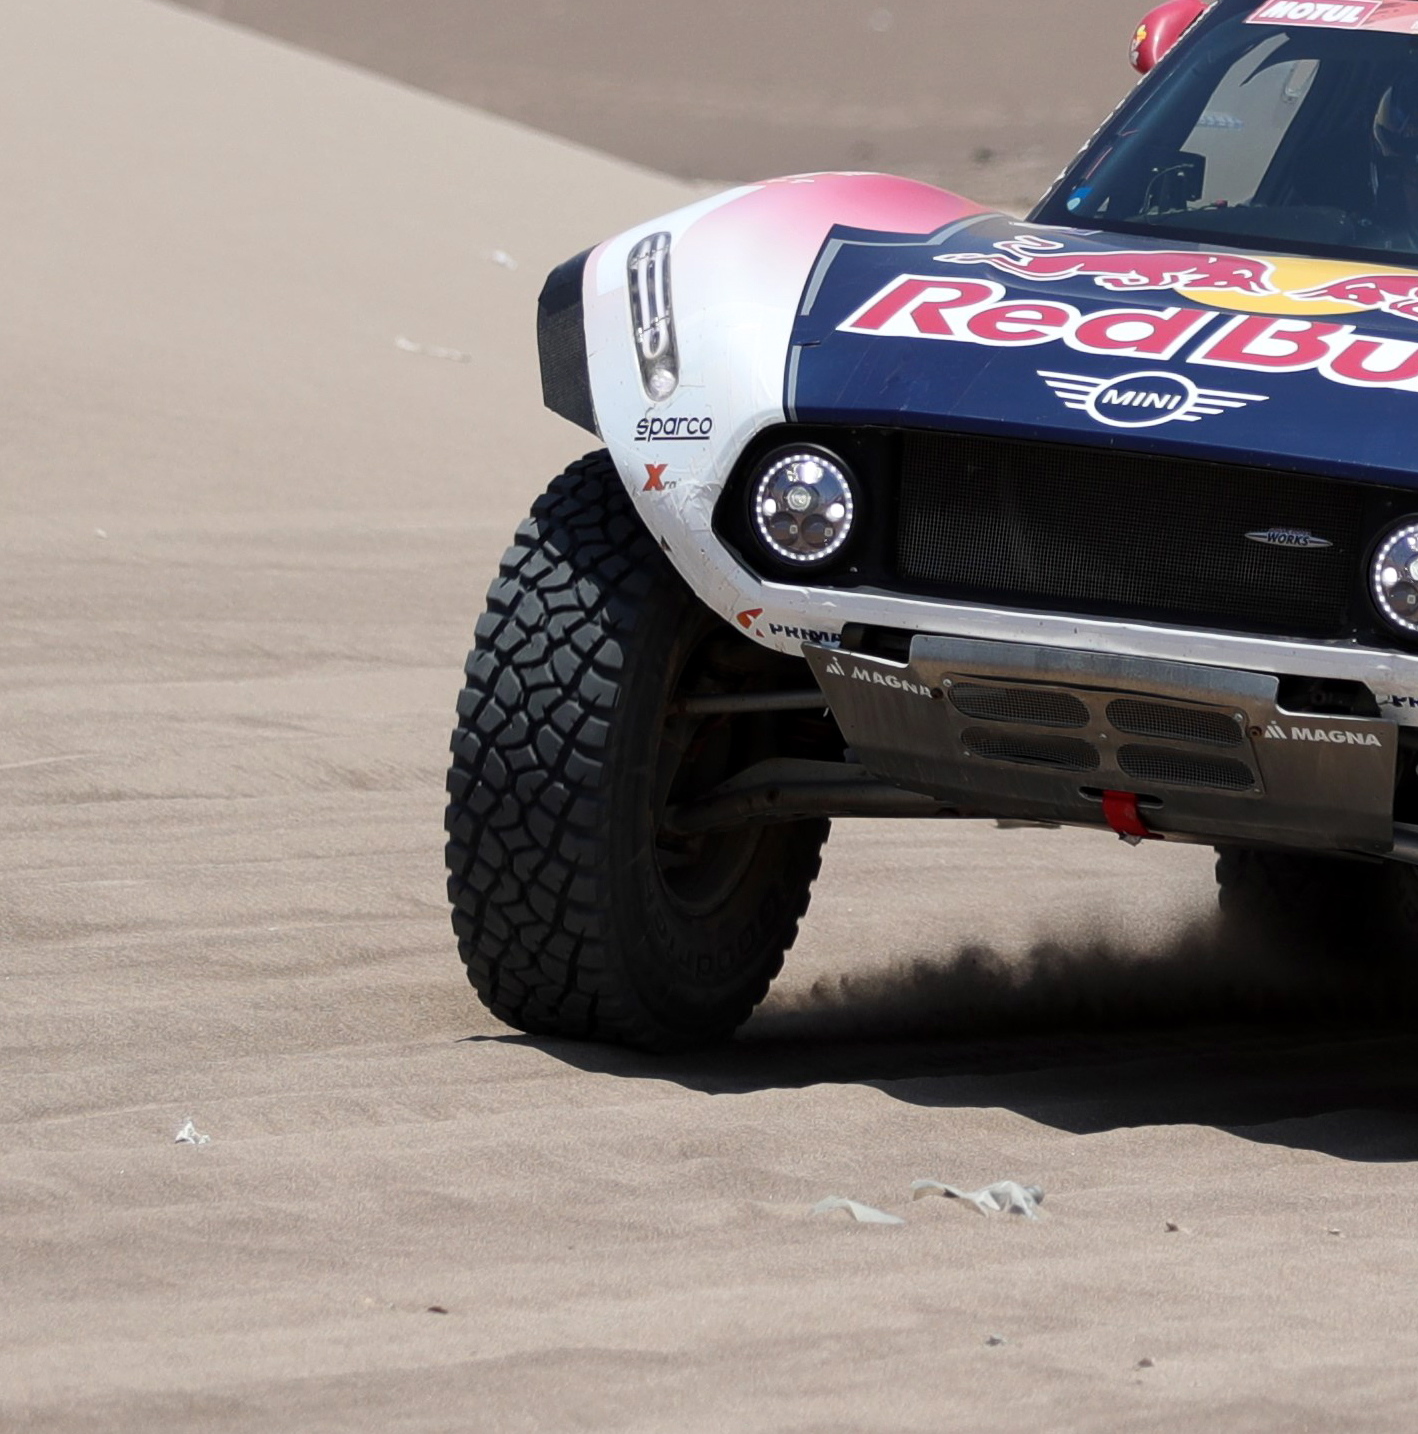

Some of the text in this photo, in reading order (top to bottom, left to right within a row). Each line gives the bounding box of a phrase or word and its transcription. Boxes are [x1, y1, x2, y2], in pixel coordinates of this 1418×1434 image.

[1259, 0, 1365, 24] MOTUL
[1102, 389, 1182, 410] MINI
[636, 417, 713, 442] sparco
[1267, 531, 1311, 547] WORKS
[768, 623, 842, 643] PRIMA
[852, 666, 933, 699] MAGNA
[1292, 727, 1382, 747] MAGNA
